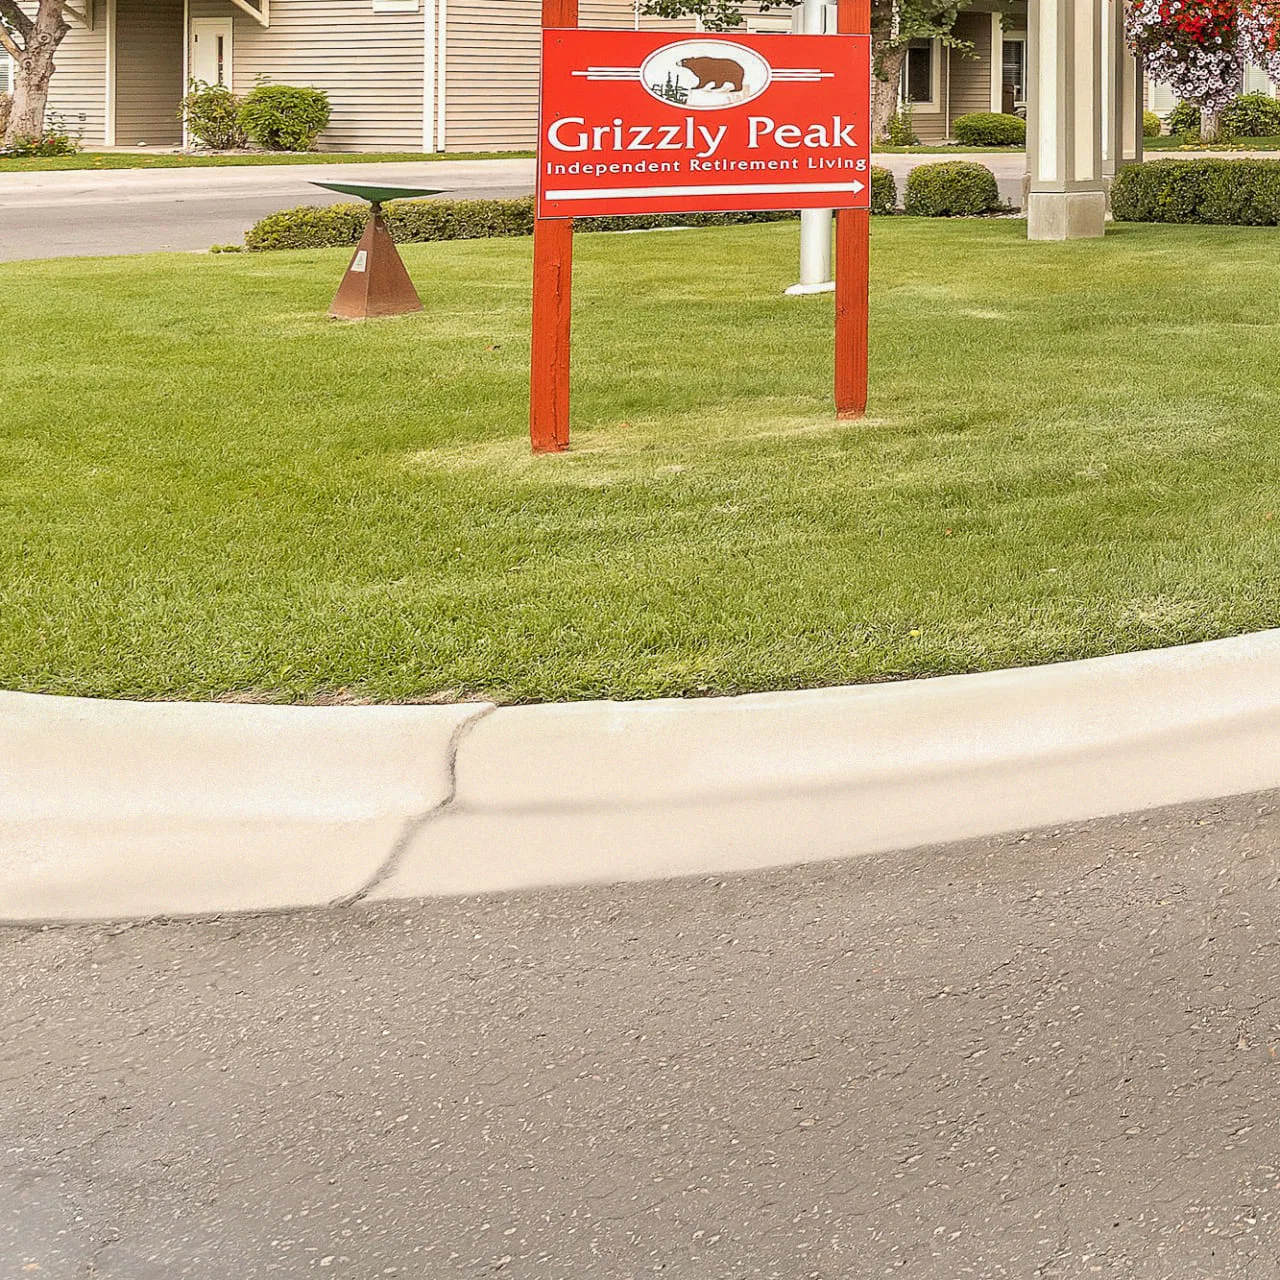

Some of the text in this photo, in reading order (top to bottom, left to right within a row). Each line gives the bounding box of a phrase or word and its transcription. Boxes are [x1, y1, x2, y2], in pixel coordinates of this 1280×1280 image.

[547, 115, 858, 158] Grizzly Peak
[546, 157, 867, 177] Independent Retirement Living
